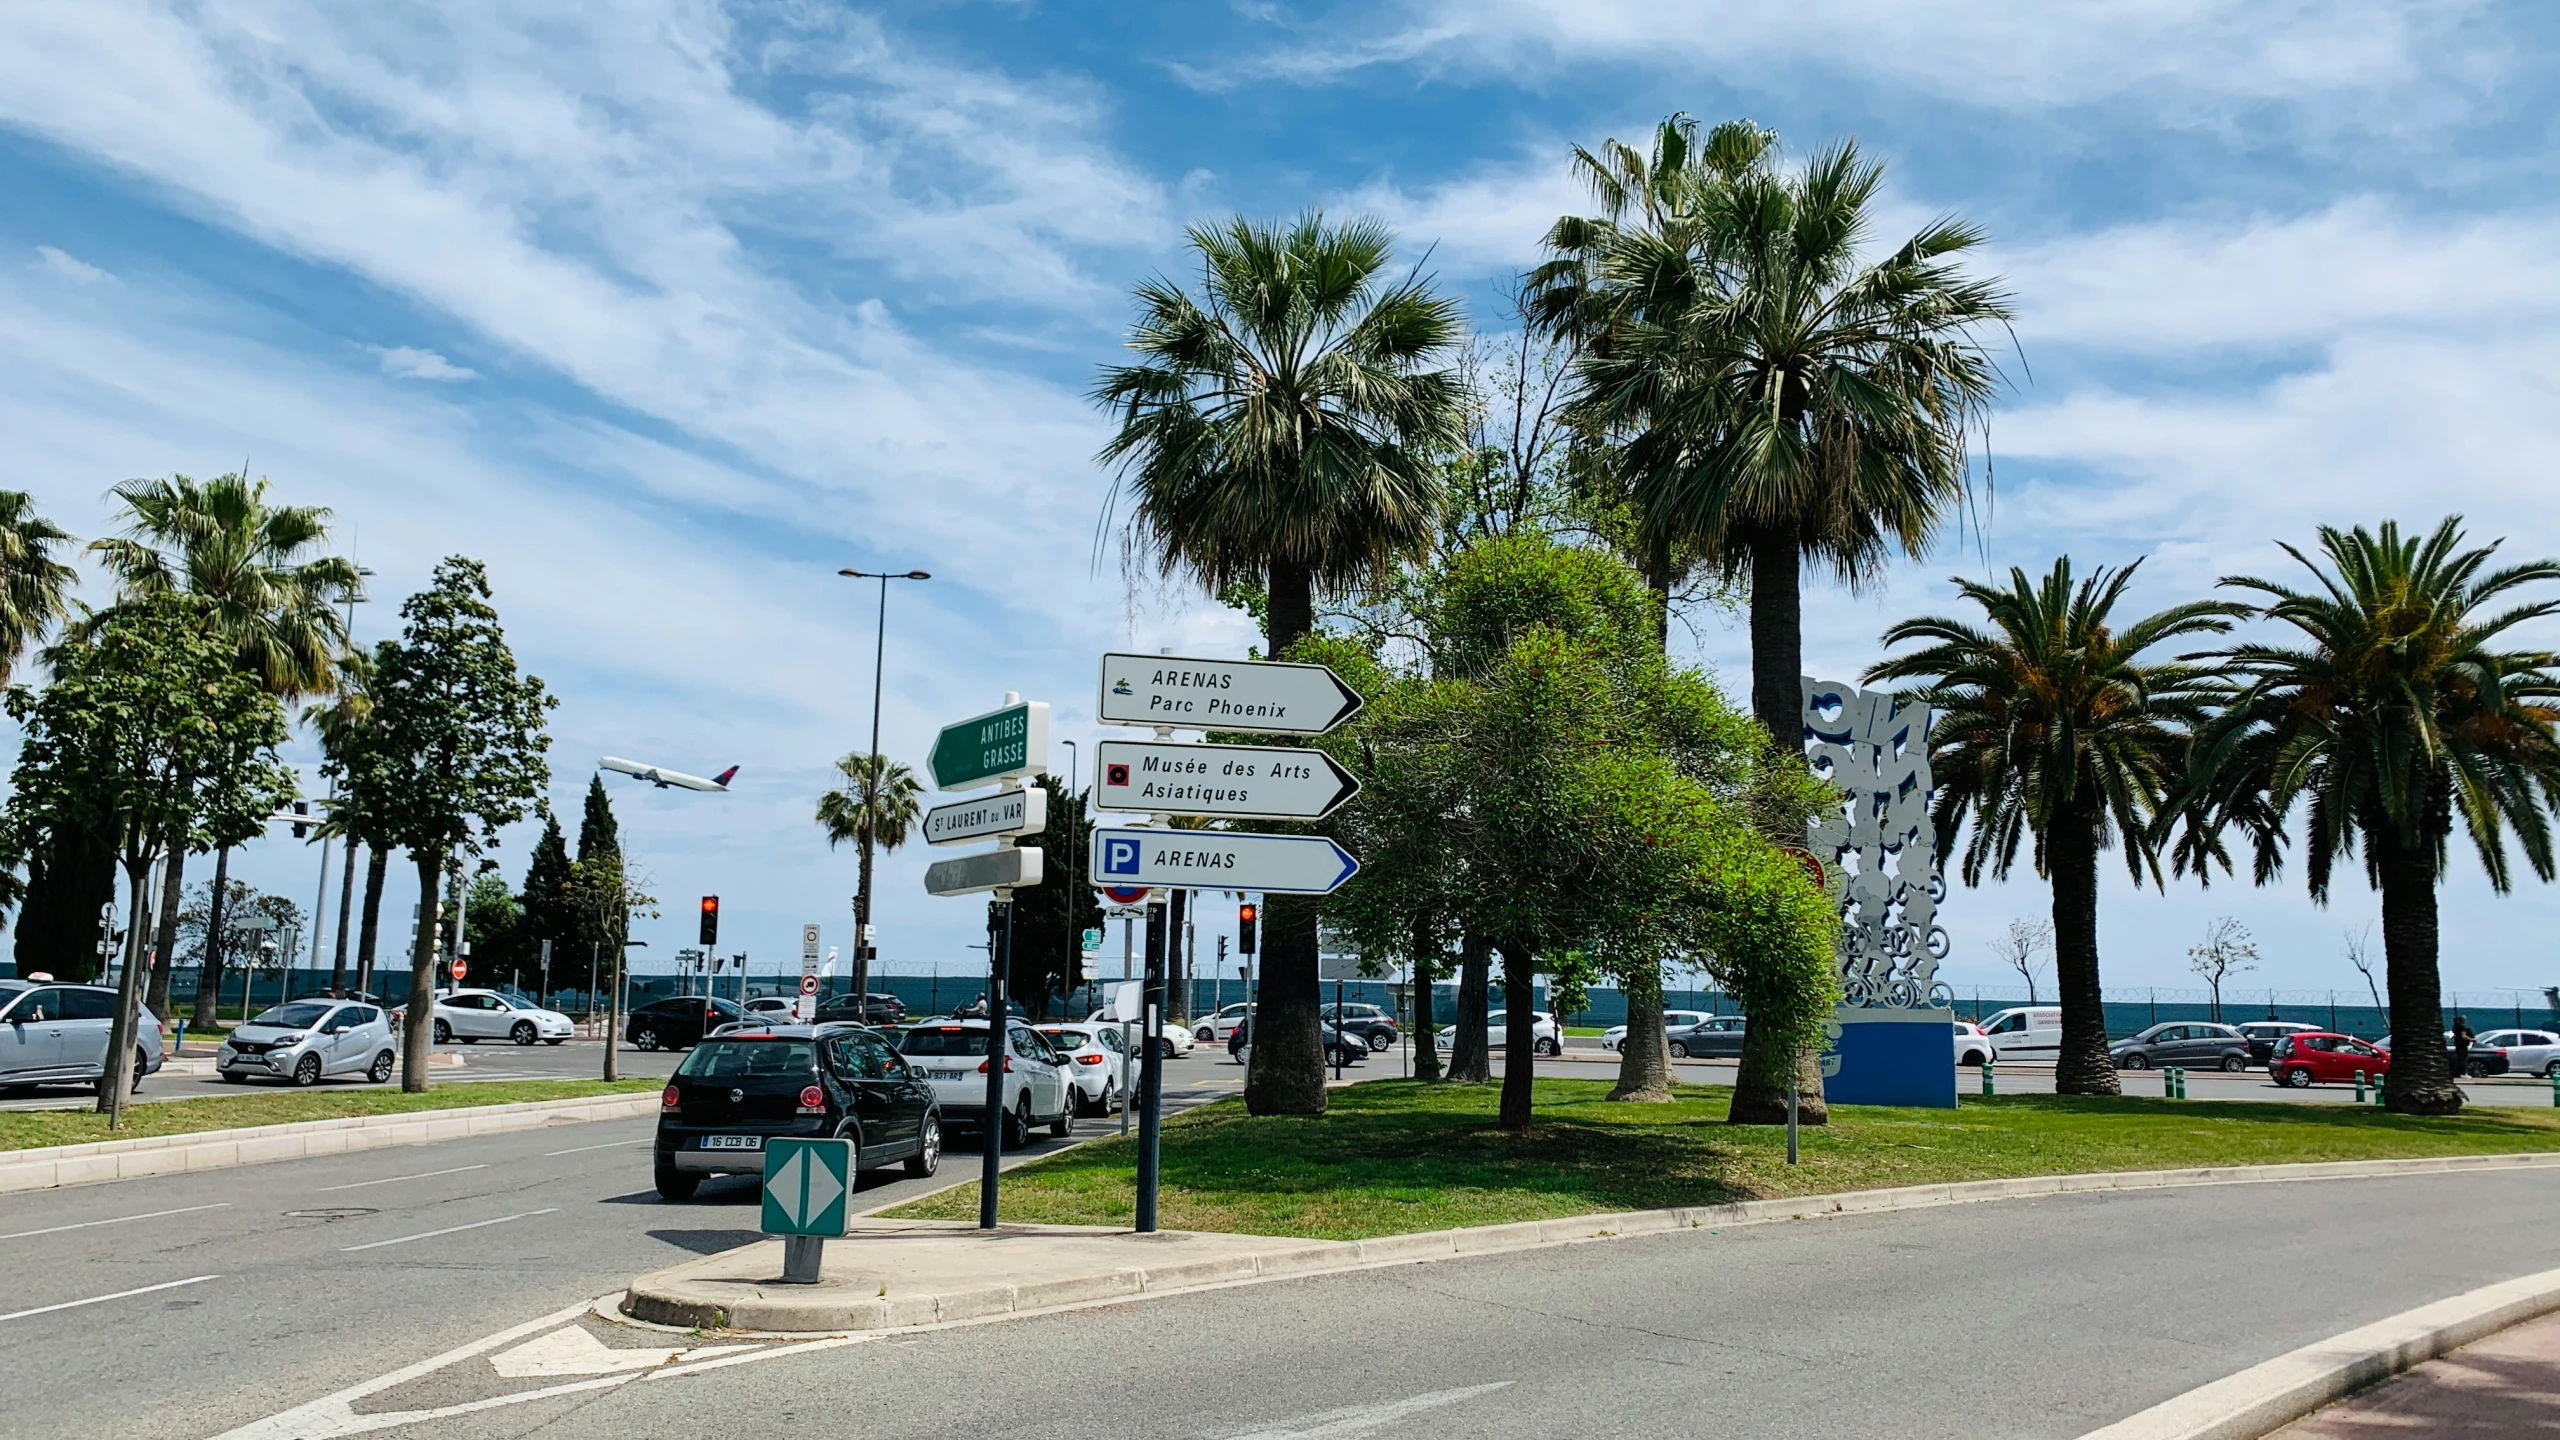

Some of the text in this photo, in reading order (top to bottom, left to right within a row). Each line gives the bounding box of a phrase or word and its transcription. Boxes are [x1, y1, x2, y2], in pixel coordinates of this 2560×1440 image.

[1151, 670, 1233, 689] ARENAS
[1149, 695, 1287, 719] Parc Phoenix
[980, 714, 1025, 745] ANTIBES
[983, 741, 1024, 769] GRASSE
[1142, 755, 1312, 780] Musée des Arts
[1141, 782, 1249, 805] Asiatiques
[947, 809, 988, 831] LAURENT
[1004, 802, 1023, 821] VAR
[1111, 843, 1237, 871] P ARENAS
[712, 1136, 757, 1147] 16 CCB 06
